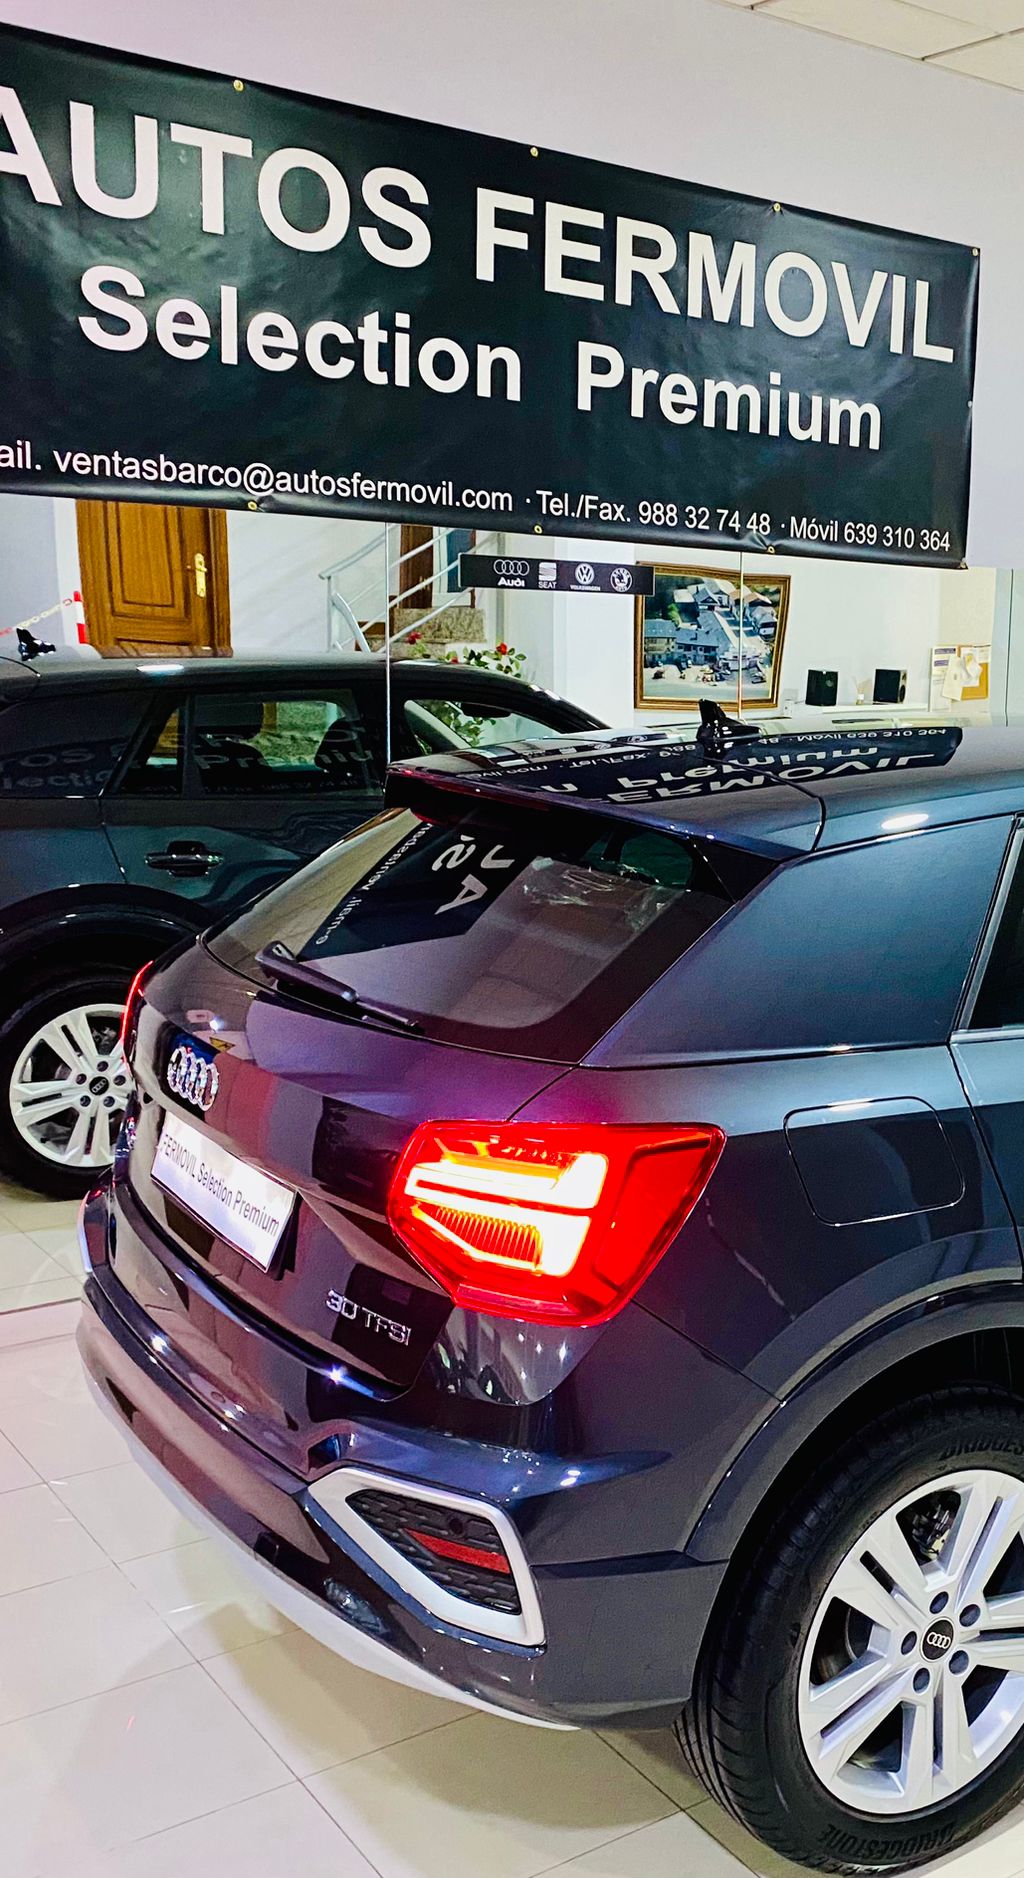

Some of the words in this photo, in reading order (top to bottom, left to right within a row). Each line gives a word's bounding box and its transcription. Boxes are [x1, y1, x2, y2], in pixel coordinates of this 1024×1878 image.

[0, 86, 431, 267] AUTOS
[477, 188, 953, 362] FERMOVIL
[79, 266, 520, 401] Selection
[578, 341, 880, 449] Premium
[53, 451, 512, 511] ventasbarco@autosfermovil.com
[536, 490, 630, 522] Tel./Fax.
[638, 501, 678, 526] 988
[685, 506, 710, 530] 32
[717, 509, 740, 533] 74
[747, 513, 771, 535] 48
[789, 517, 839, 544] Móvil
[844, 522, 877, 545] 639
[883, 526, 914, 548] 310
[920, 530, 951, 551] 364
[497, 576, 525, 588] Audi
[538, 581, 557, 589] SEAT
[161, 1134, 196, 1178] FERMOVIL
[197, 1162, 233, 1208] Selection
[232, 1189, 280, 1237] Premium
[326, 1289, 357, 1320] 30
[361, 1306, 412, 1346] TFSI
